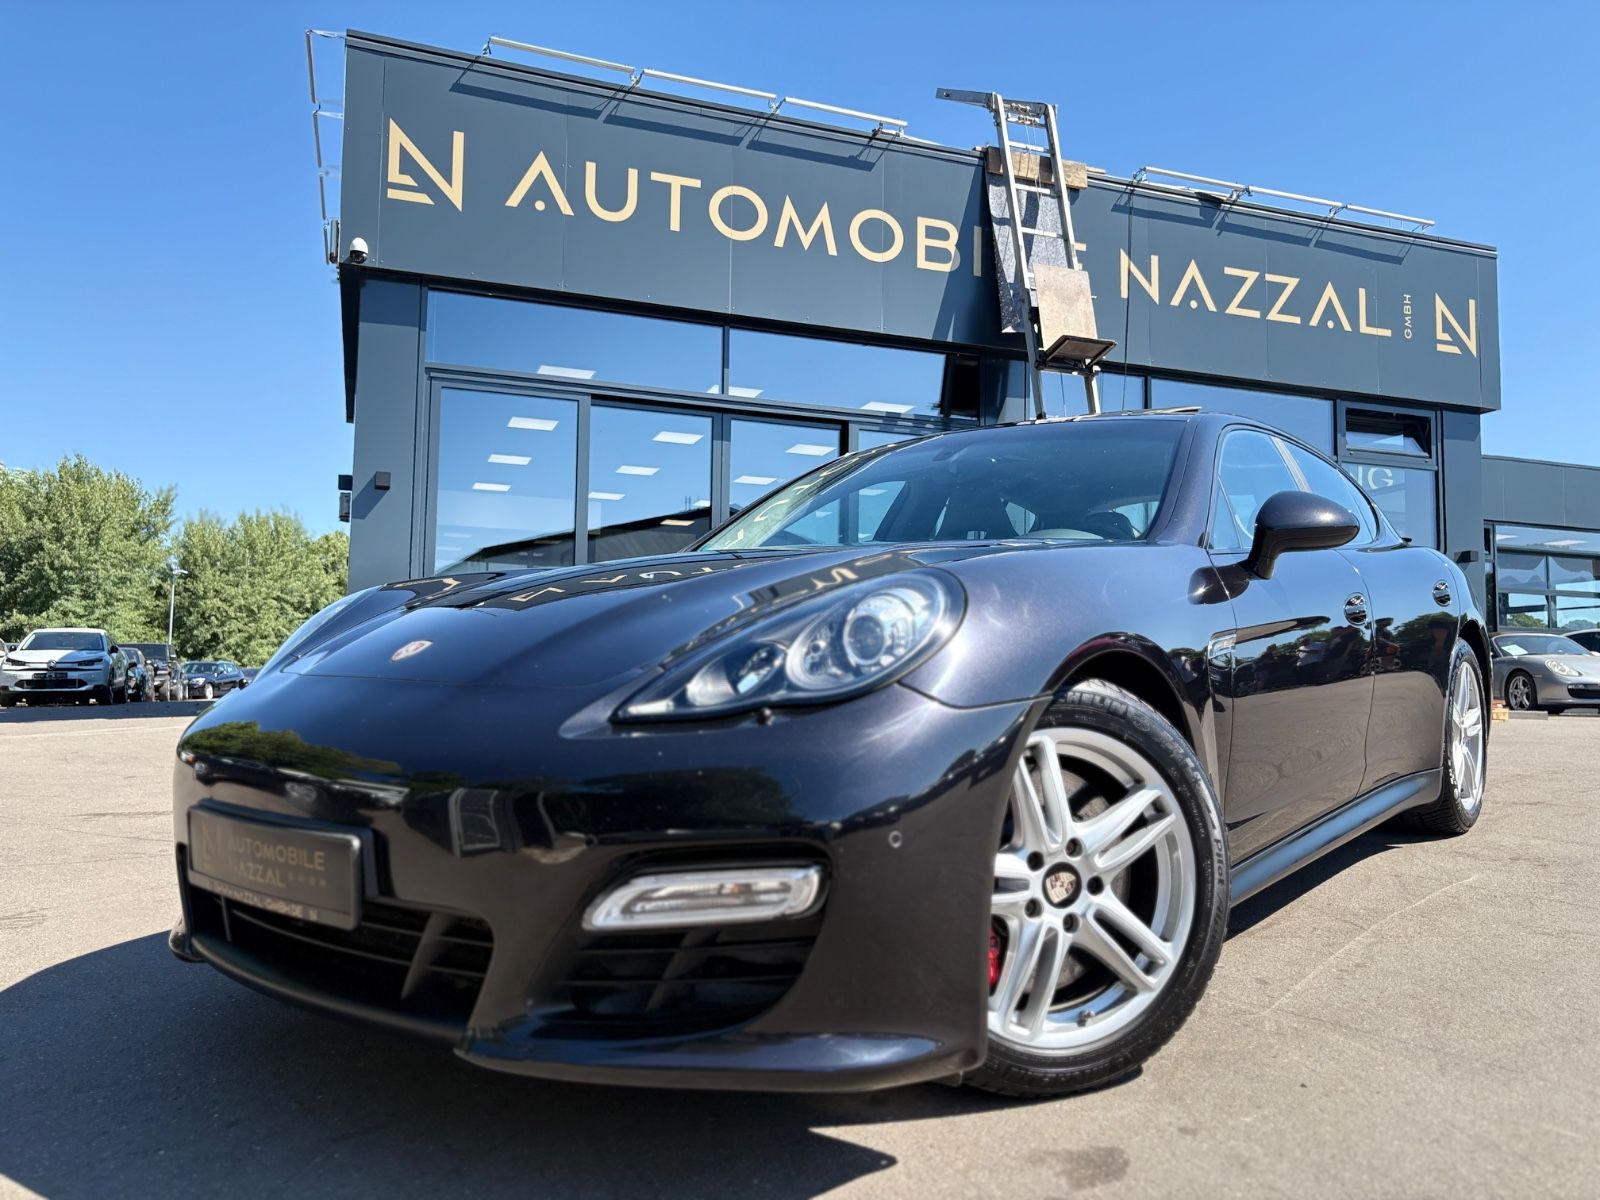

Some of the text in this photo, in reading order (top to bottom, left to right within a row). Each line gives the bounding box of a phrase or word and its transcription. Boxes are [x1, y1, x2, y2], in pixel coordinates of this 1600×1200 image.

[505, 150, 1097, 300] AUTOMOBI
[1120, 248, 1392, 338] NAZZAL
[1402, 293, 1413, 340] GMBH
[228, 837, 326, 870] AUTOMOBILE
